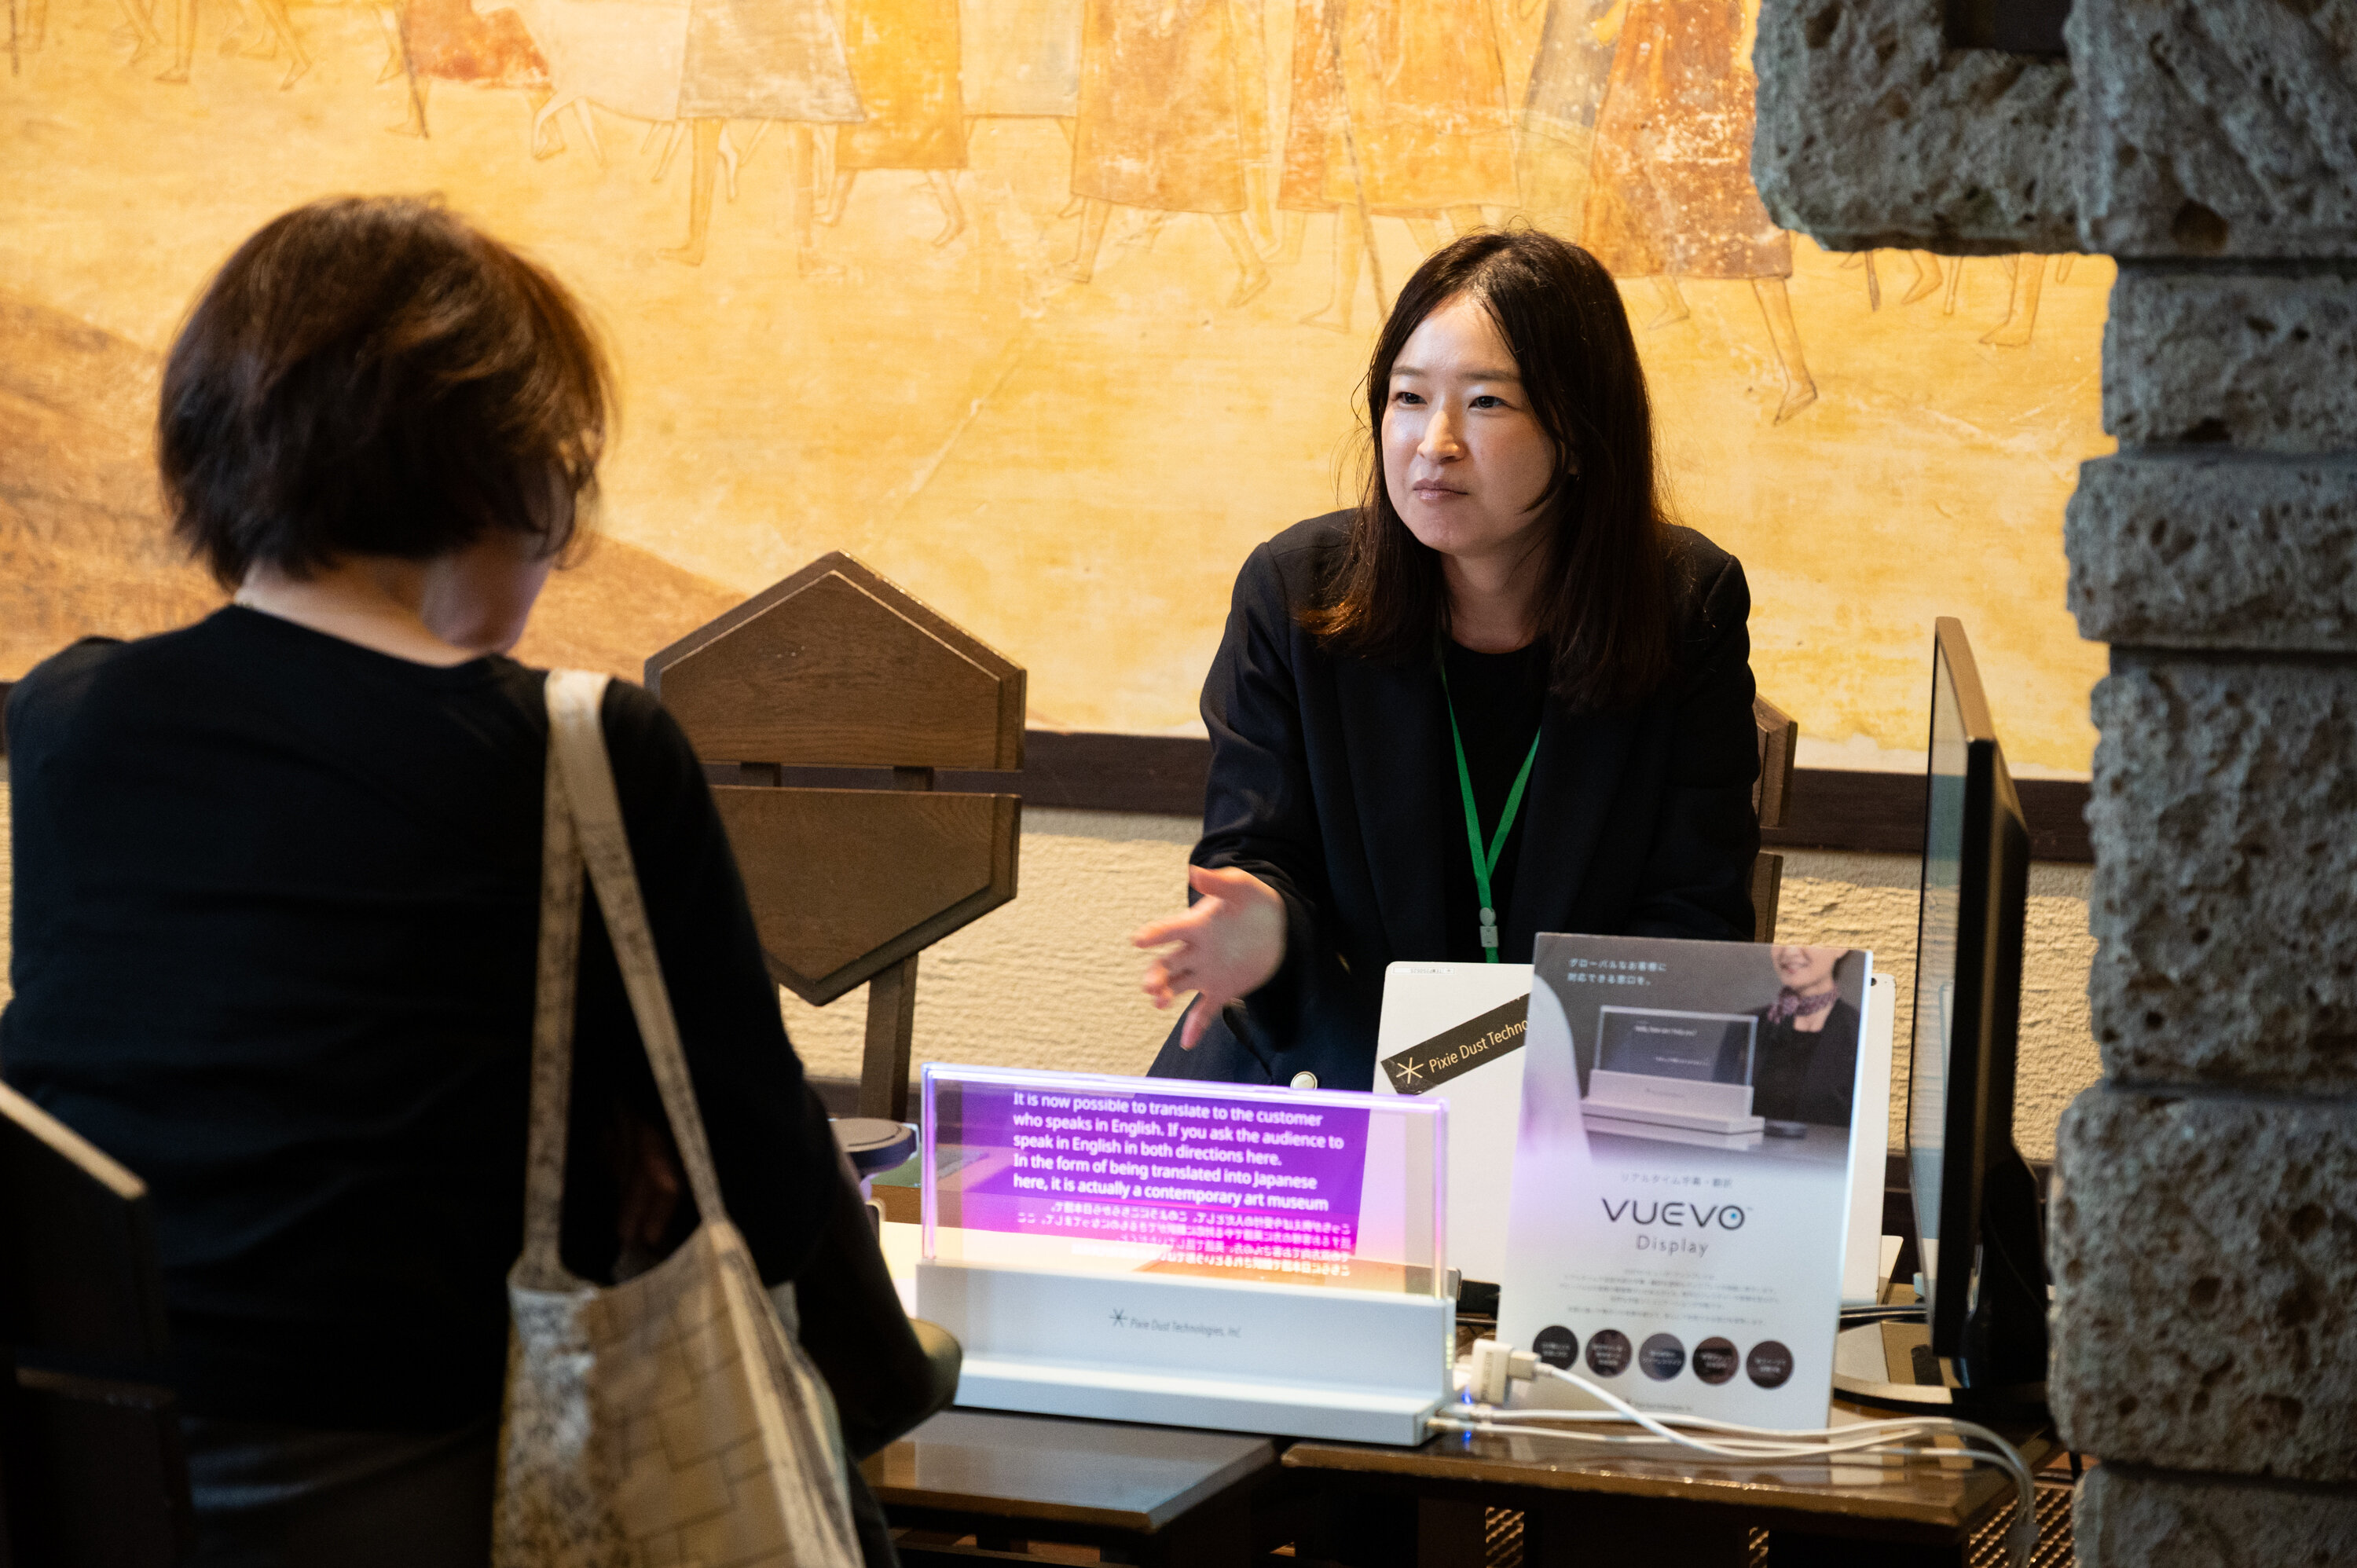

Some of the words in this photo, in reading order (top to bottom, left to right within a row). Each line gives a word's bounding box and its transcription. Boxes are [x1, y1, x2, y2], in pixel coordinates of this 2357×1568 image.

[1429, 1053, 1458, 1073] Pixie
[1459, 1038, 1490, 1059] Dust
[1486, 1020, 1528, 1046] Techno
[1014, 1092, 1025, 1105] It
[1028, 1093, 1039, 1107] is
[1041, 1095, 1071, 1108] now
[1073, 1097, 1129, 1112] possible
[1131, 1101, 1147, 1114] to
[1149, 1101, 1210, 1119] translate
[1212, 1107, 1228, 1120] to
[1230, 1107, 1255, 1122] the
[1256, 1110, 1324, 1127] customer
[1013, 1112, 1043, 1127] who
[1045, 1116, 1092, 1132] speaks
[1095, 1117, 1109, 1132] in
[1111, 1119, 1164, 1138] English.
[1168, 1122, 1178, 1138] If
[1180, 1127, 1208, 1141] you
[1209, 1126, 1233, 1141] ask
[1236, 1127, 1260, 1143] the
[1263, 1130, 1326, 1148] audience
[1329, 1135, 1344, 1149] to
[1014, 1134, 1054, 1149] speak
[1056, 1135, 1069, 1150] in
[1072, 1137, 1121, 1156] English
[1124, 1140, 1138, 1155] in
[1141, 1141, 1173, 1158] both
[1175, 1144, 1244, 1163] directions
[1245, 1149, 1282, 1166] here.
[1014, 1153, 1028, 1167] In
[1031, 1154, 1054, 1170] the
[1056, 1156, 1090, 1172] form
[1092, 1159, 1108, 1173] of
[1109, 1160, 1149, 1180] being
[1152, 1164, 1222, 1182] translated
[1223, 1168, 1252, 1185] into
[1252, 1171, 1318, 1189] Japanese
[1014, 1173, 1048, 1191] here,
[1051, 1176, 1061, 1191] it
[1064, 1178, 1076, 1192] is
[1077, 1180, 1131, 1200] actually
[1132, 1185, 1142, 1197] a
[1144, 1185, 1242, 1207] contemporary
[1244, 1192, 1265, 1207] art
[1267, 1195, 1329, 1211] museum
[1602, 1197, 1745, 1230] VUEVO
[1637, 1235, 1709, 1258] Display
